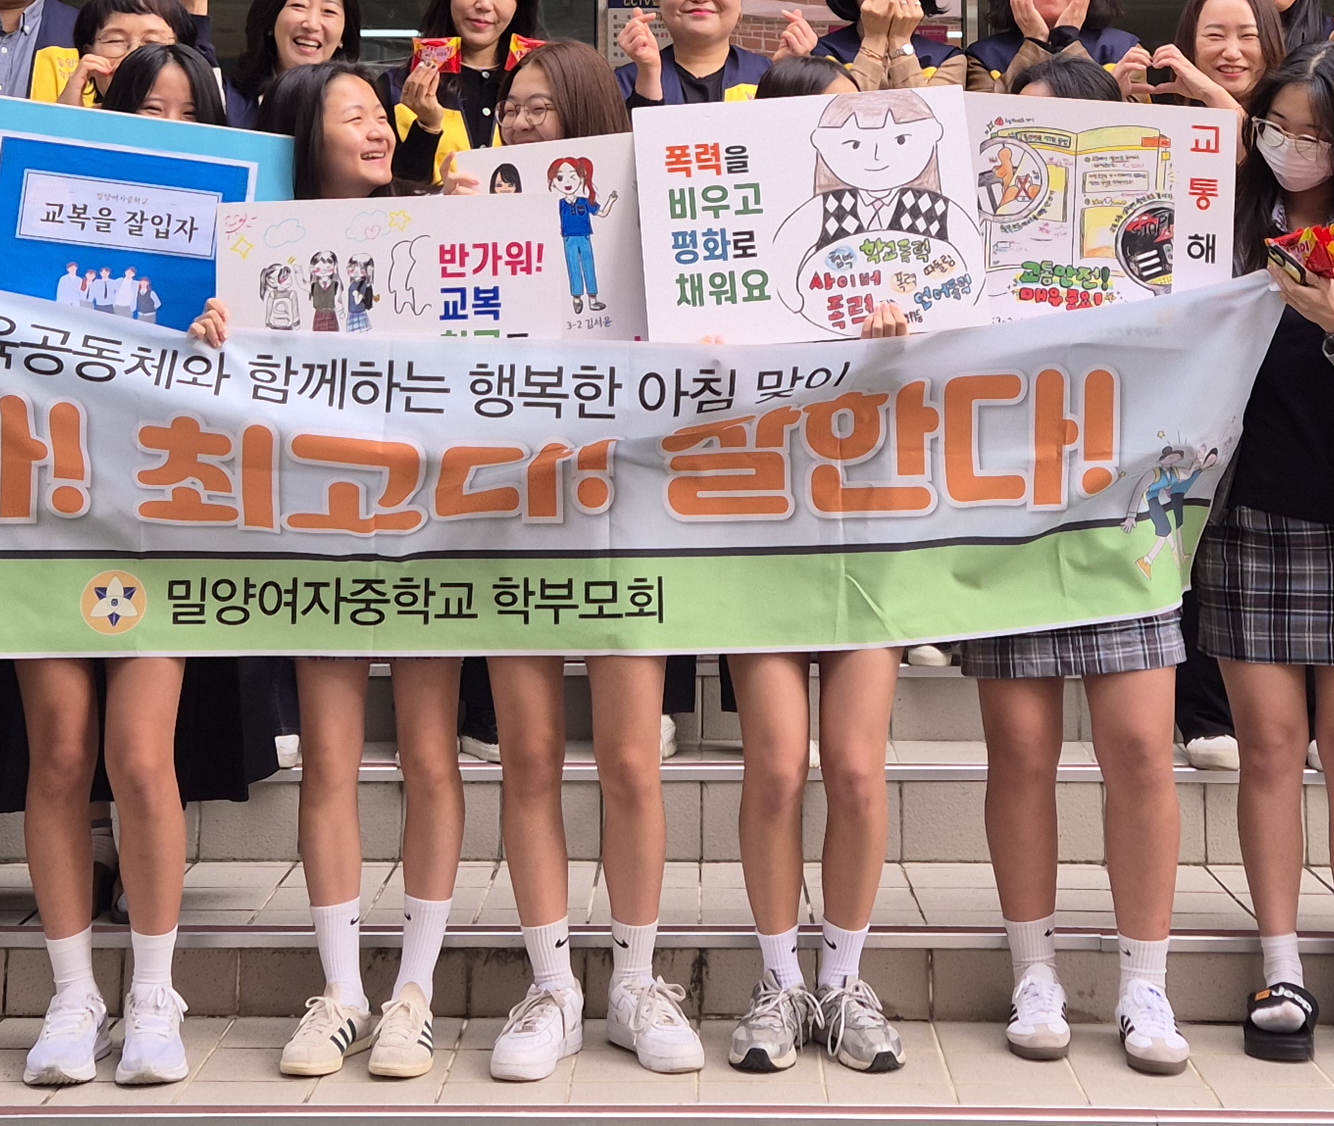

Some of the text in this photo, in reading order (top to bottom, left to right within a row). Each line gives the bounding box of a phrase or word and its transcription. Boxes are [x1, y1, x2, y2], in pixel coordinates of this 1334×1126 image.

[664, 141, 750, 178] 폭력을
[668, 181, 764, 221] 비우고
[39, 201, 199, 244] 교복을 잘입자
[437, 241, 545, 279] 반가워!
[671, 227, 758, 265] 평화로
[828, 249, 855, 270] 협박
[858, 237, 932, 265] 학교폭력
[675, 268, 772, 308] 채워요
[808, 269, 882, 291] 사이버
[895, 271, 917, 293] 폭력
[913, 273, 973, 312] 언어폭력
[1018, 260, 1111, 292] 교통안전!
[438, 285, 502, 321] 교복
[247, 353, 452, 415] 함께하는
[468, 362, 624, 422] 행복한
[637, 367, 737, 418] 아침
[754, 360, 851, 405] 맞이
[137, 415, 619, 535] 최고다!
[661, 368, 1115, 517] 잘한다!
[167, 574, 665, 626] 밀양여자중학교 학부모회
[1271, 985, 1314, 1015] Jeep
